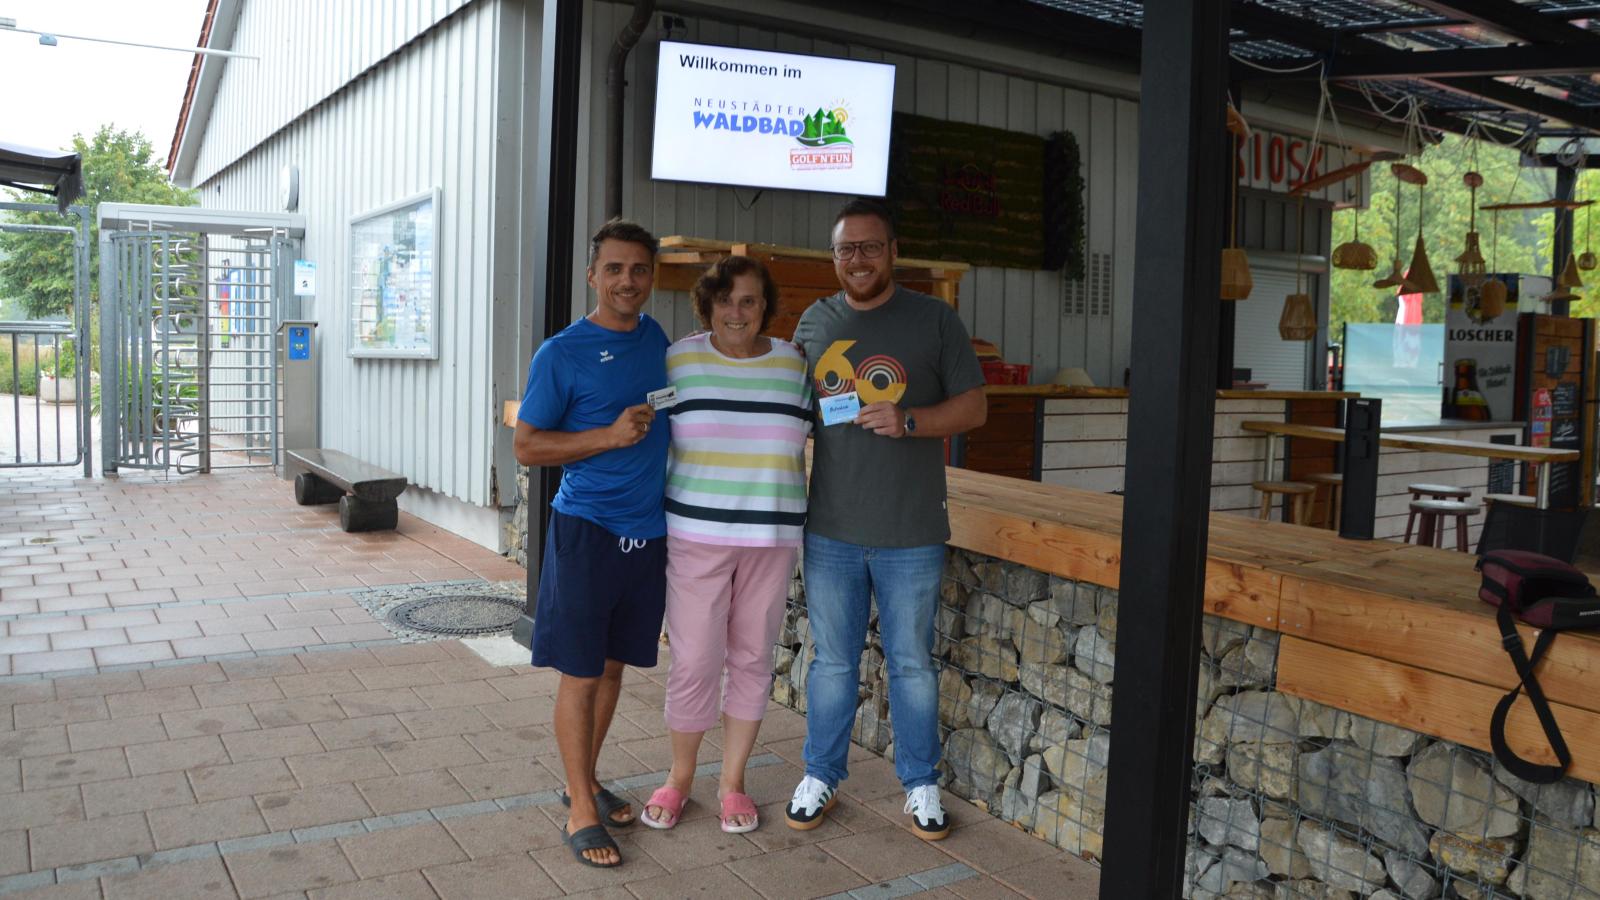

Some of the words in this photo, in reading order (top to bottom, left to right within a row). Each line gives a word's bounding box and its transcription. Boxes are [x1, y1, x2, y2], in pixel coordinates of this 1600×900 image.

[679, 54, 778, 77] Willkommen
[783, 64, 802, 80] im
[694, 97, 805, 116] NEUSTÄDTER
[693, 110, 804, 138] WALDBAD
[1449, 328, 1515, 343] LOSCHER
